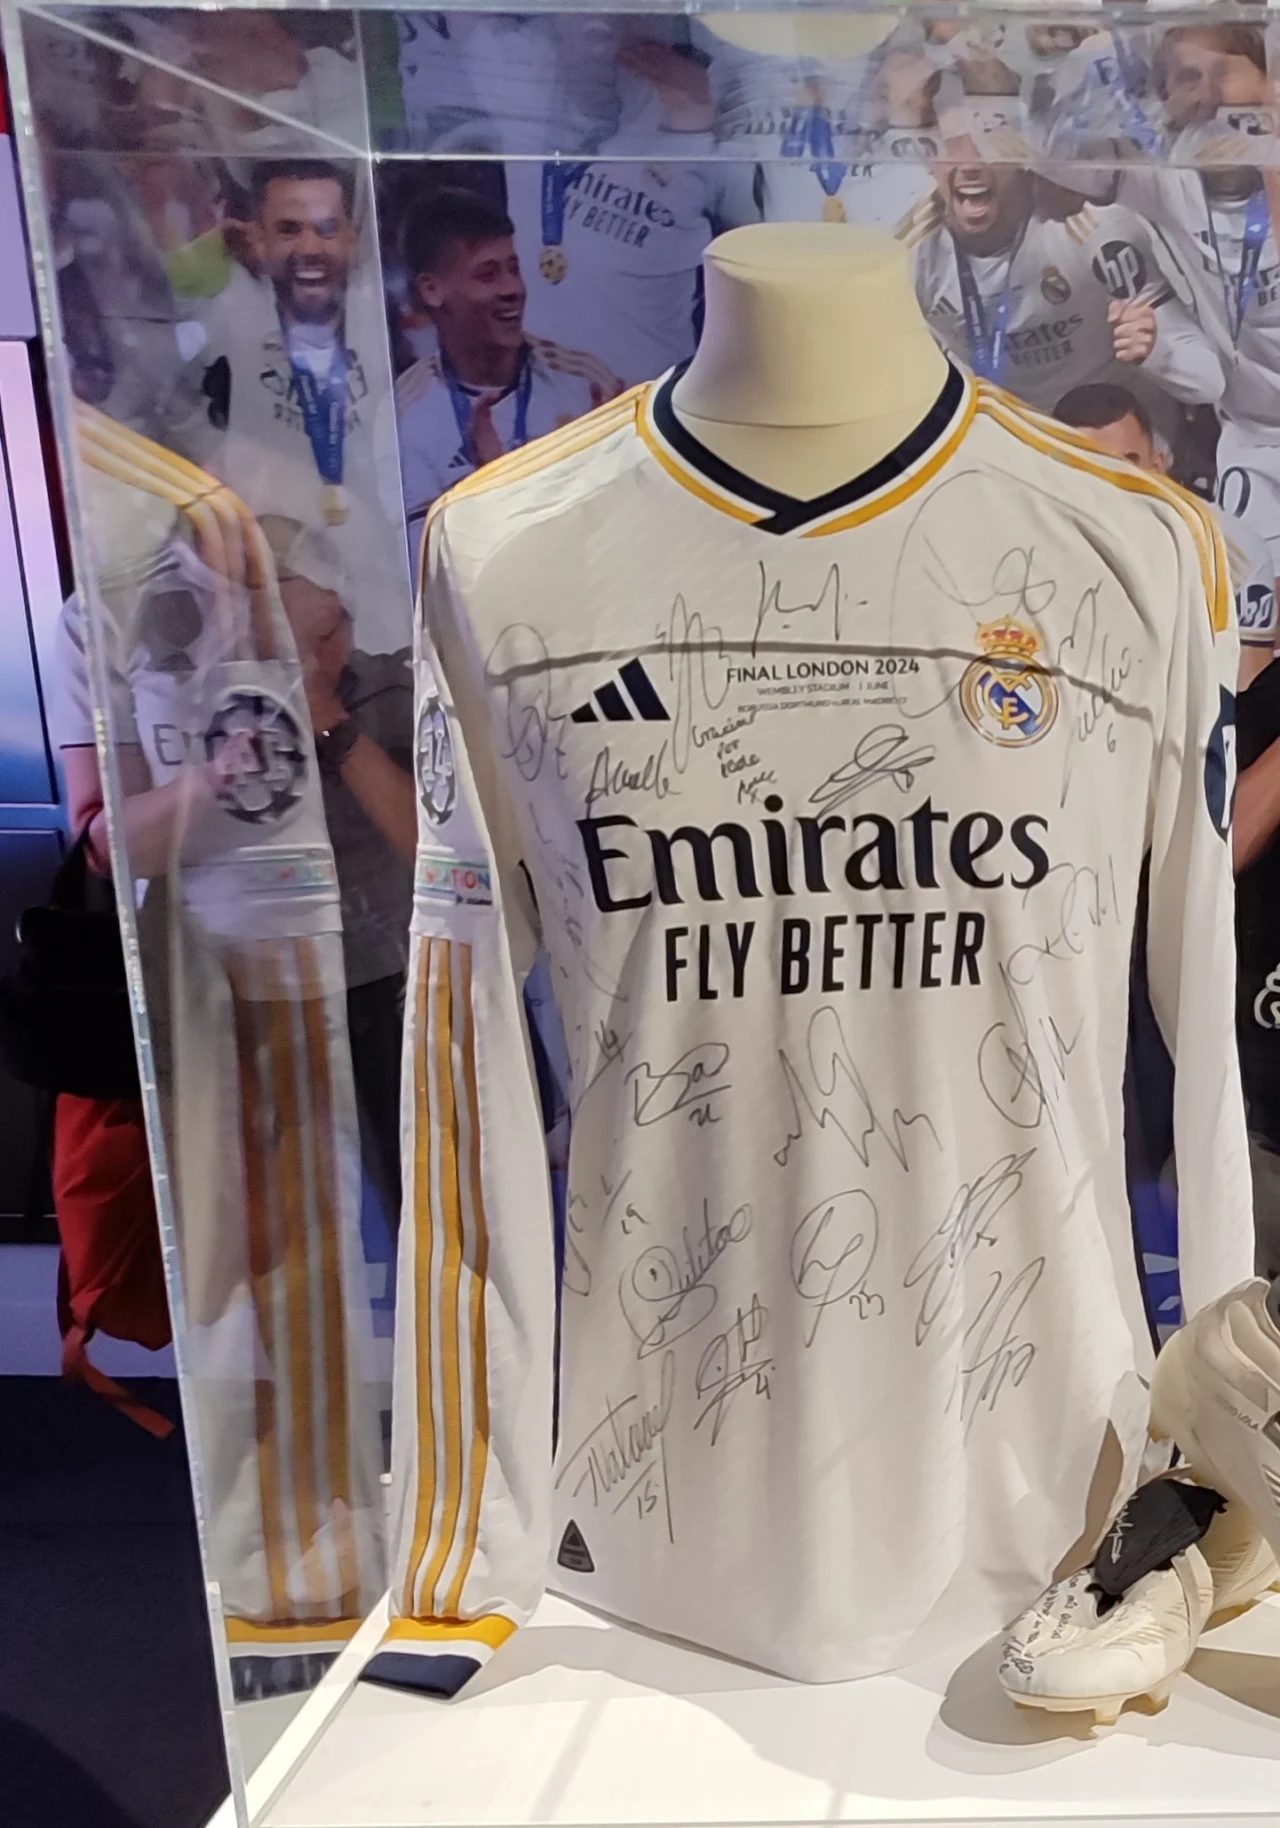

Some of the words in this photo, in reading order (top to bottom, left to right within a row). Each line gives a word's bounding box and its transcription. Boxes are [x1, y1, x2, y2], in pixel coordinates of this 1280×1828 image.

[1093, 243, 1141, 302] hp
[727, 664, 782, 683] FINAL
[786, 660, 869, 679] LONDON
[874, 658, 920, 675] 2024
[757, 683, 805, 696] WEMBLEY
[807, 682, 850, 694] STADIUM
[577, 795, 1050, 912] Emirates
[665, 921, 756, 1002] FLY
[781, 911, 986, 995] BETTER
